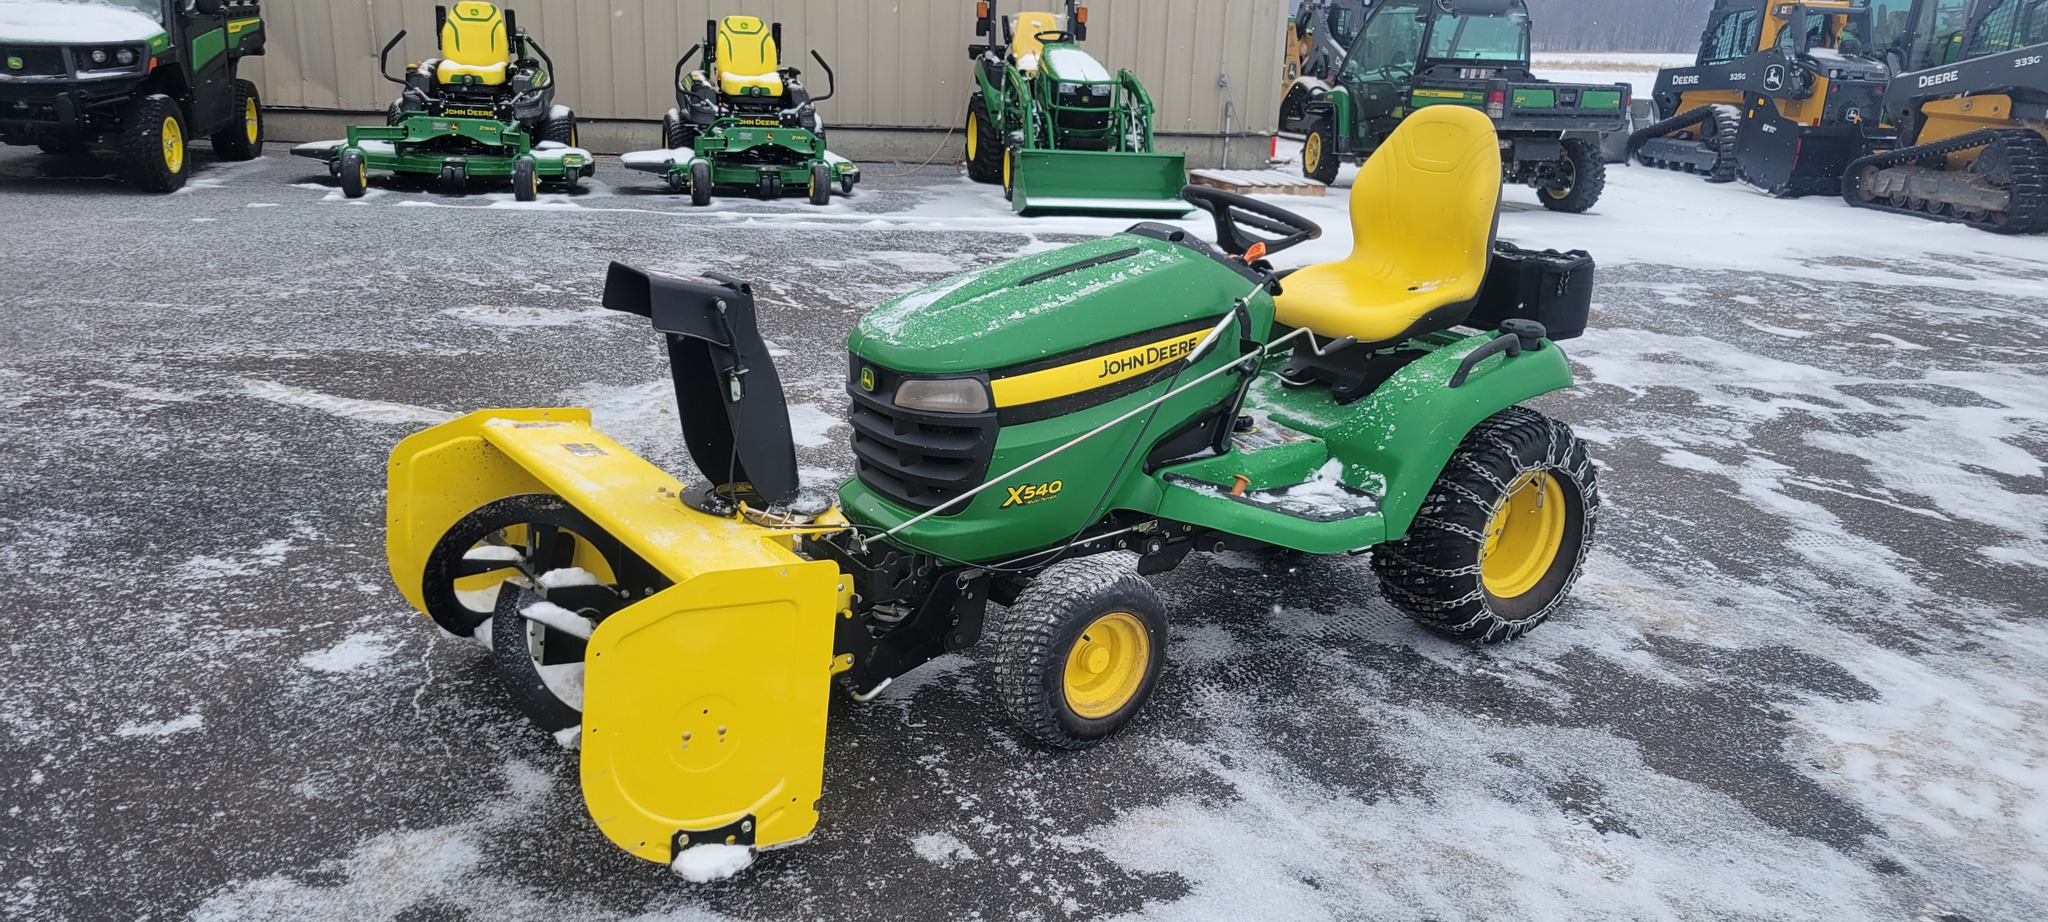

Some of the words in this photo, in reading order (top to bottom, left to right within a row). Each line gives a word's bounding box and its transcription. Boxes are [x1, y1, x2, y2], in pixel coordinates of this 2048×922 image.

[2014, 56, 2041, 68] 333G
[1672, 75, 1700, 85] DEERE
[1729, 73, 1746, 81] 325G
[1918, 70, 1959, 88] DEERE
[444, 108, 466, 116] JOHN
[467, 109, 494, 117] DEERE
[755, 118, 780, 126] DEERE
[1098, 353, 1144, 378] JOHN
[1146, 337, 1198, 365] DEERE
[1001, 479, 1063, 508] X540
